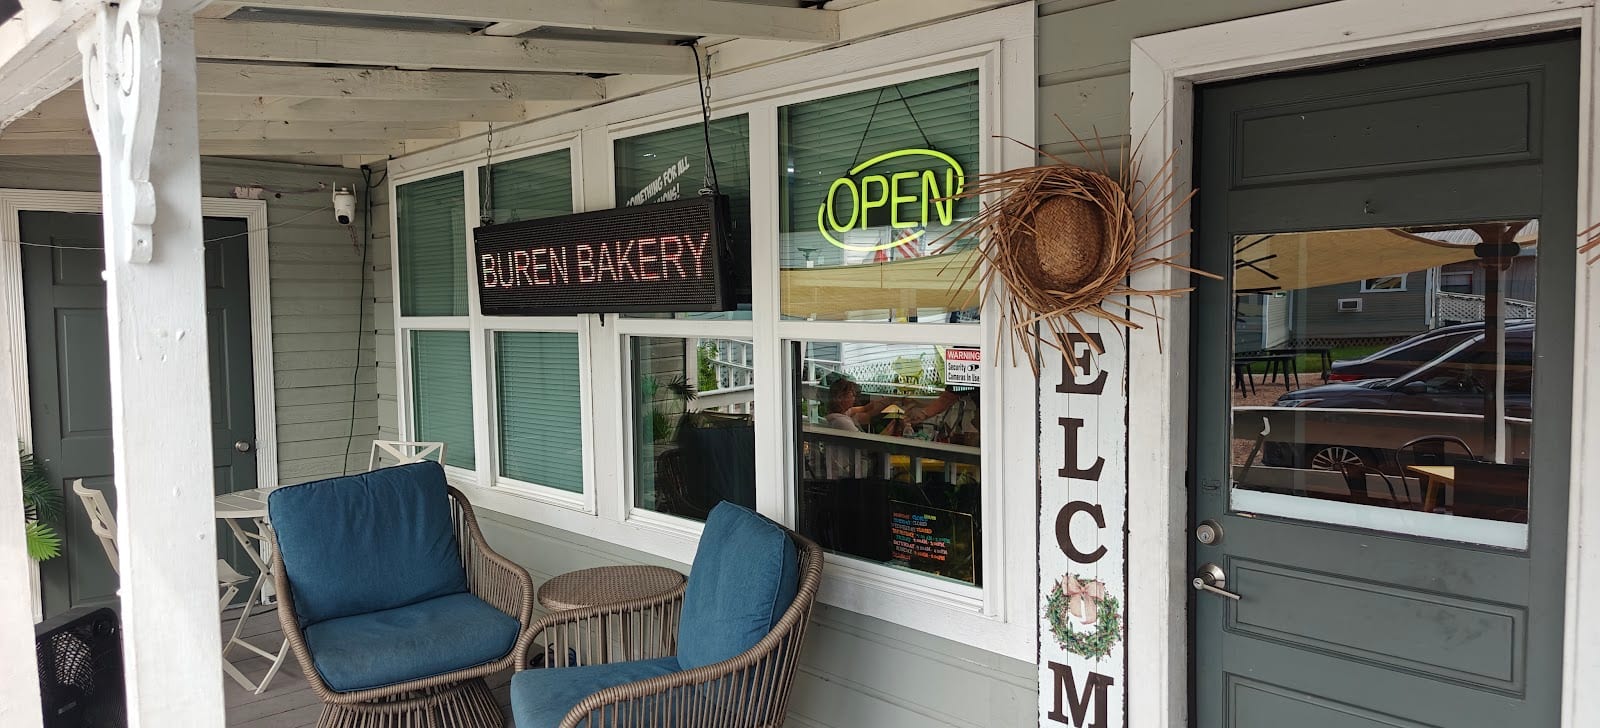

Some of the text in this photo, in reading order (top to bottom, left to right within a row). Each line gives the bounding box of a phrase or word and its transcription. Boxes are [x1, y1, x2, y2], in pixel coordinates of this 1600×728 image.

[663, 165, 677, 186] FOR
[678, 156, 690, 177] ALL
[827, 168, 953, 232] OPEN
[482, 232, 709, 288] BUREN BAKERY
[947, 350, 980, 360] WARNING
[948, 362, 966, 373] Security
[948, 372, 966, 381] Cameras
[972, 374, 980, 382] Use
